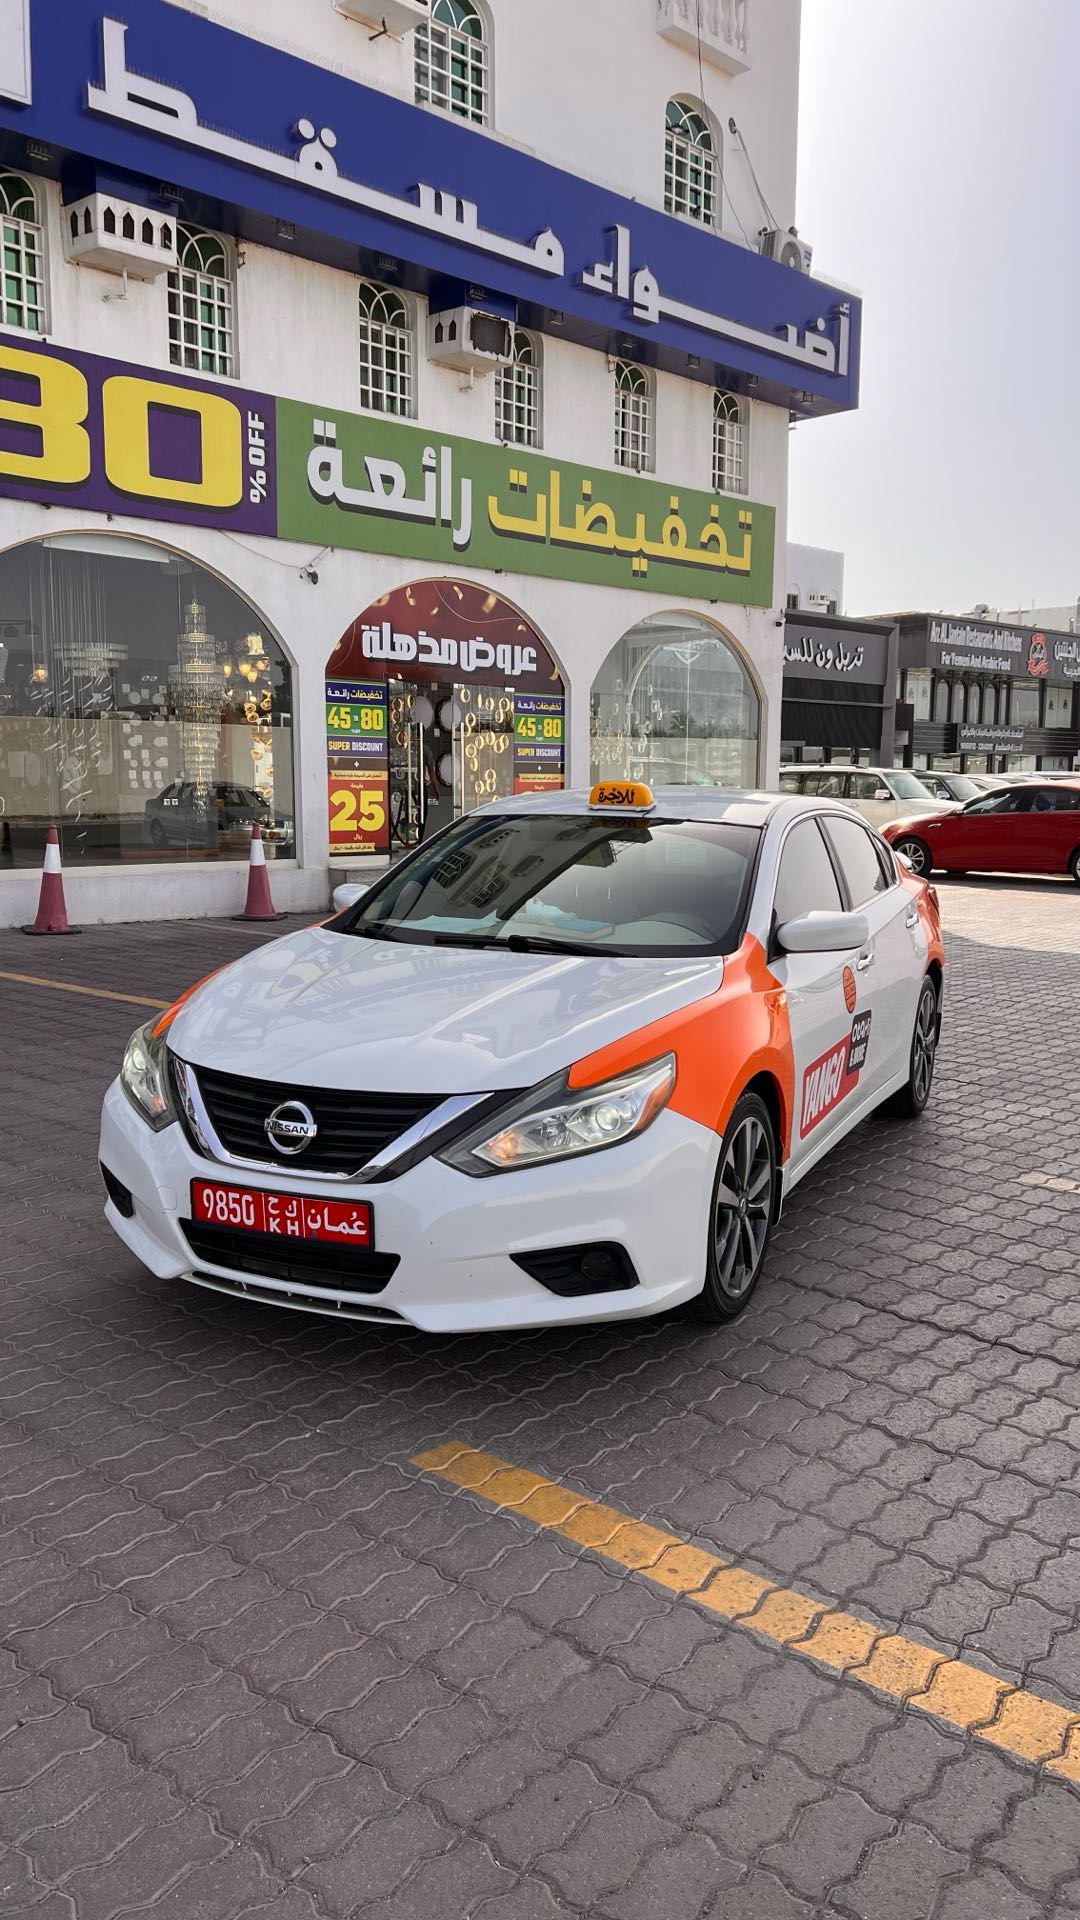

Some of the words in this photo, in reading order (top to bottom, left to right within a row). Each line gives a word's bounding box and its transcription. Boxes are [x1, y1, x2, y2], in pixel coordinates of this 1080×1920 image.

[87, 17, 565, 277] مسقط
[582, 224, 850, 376] أضواء
[307, 418, 472, 548] رائعة
[487, 468, 752, 573] تخفيضات
[361, 622, 458, 666] مذهلة
[460, 637, 538, 676] عروض
[998, 657, 1011, 671] Food
[350, 689, 383, 701] تخفيضات
[327, 706, 351, 730] 45
[360, 708, 384, 731] 80
[517, 717, 536, 737] 45
[543, 718, 562, 738] 80
[328, 741, 350, 751] SUPER
[352, 742, 383, 752] DISCOUNT
[517, 747, 535, 757] SUPER
[536, 748, 561, 757] DISCOUNT
[329, 789, 385, 832] 25
[802, 1046, 846, 1130] YANGO
[266, 1120, 310, 1136] NISSAN
[202, 1188, 255, 1226] 9850
